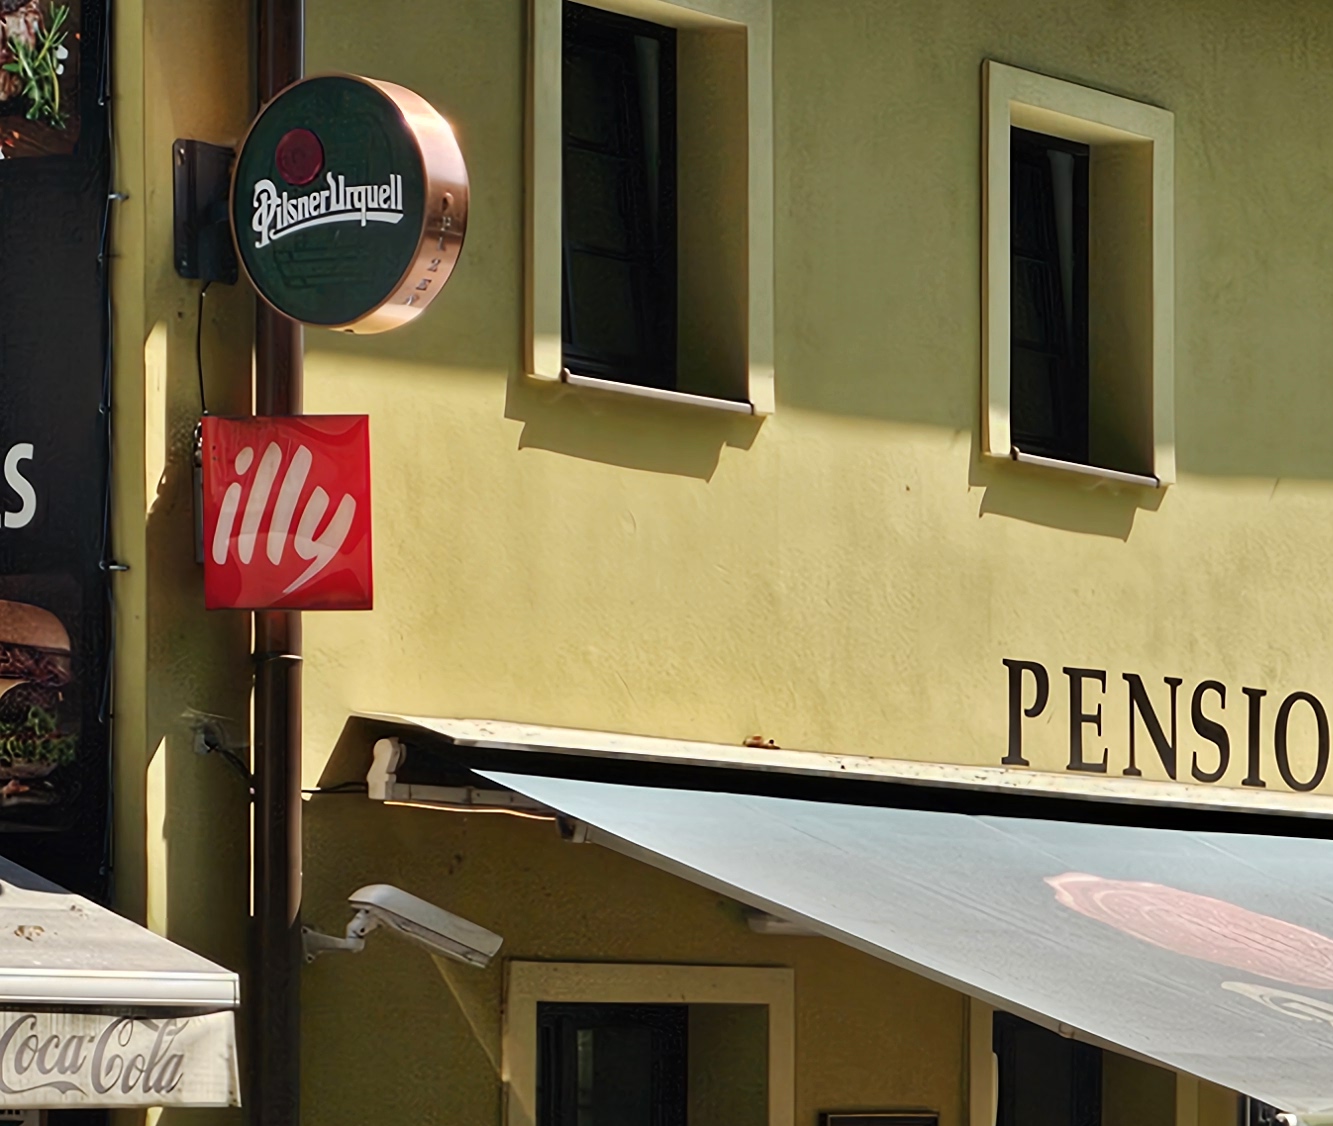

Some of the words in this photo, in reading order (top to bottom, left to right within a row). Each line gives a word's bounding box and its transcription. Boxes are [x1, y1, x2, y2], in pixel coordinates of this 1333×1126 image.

[252, 178, 331, 249] Pilsner
[327, 171, 404, 227] Urquell
[211, 443, 357, 594] illy
[0, 1013, 190, 1095] Coca-Cola
